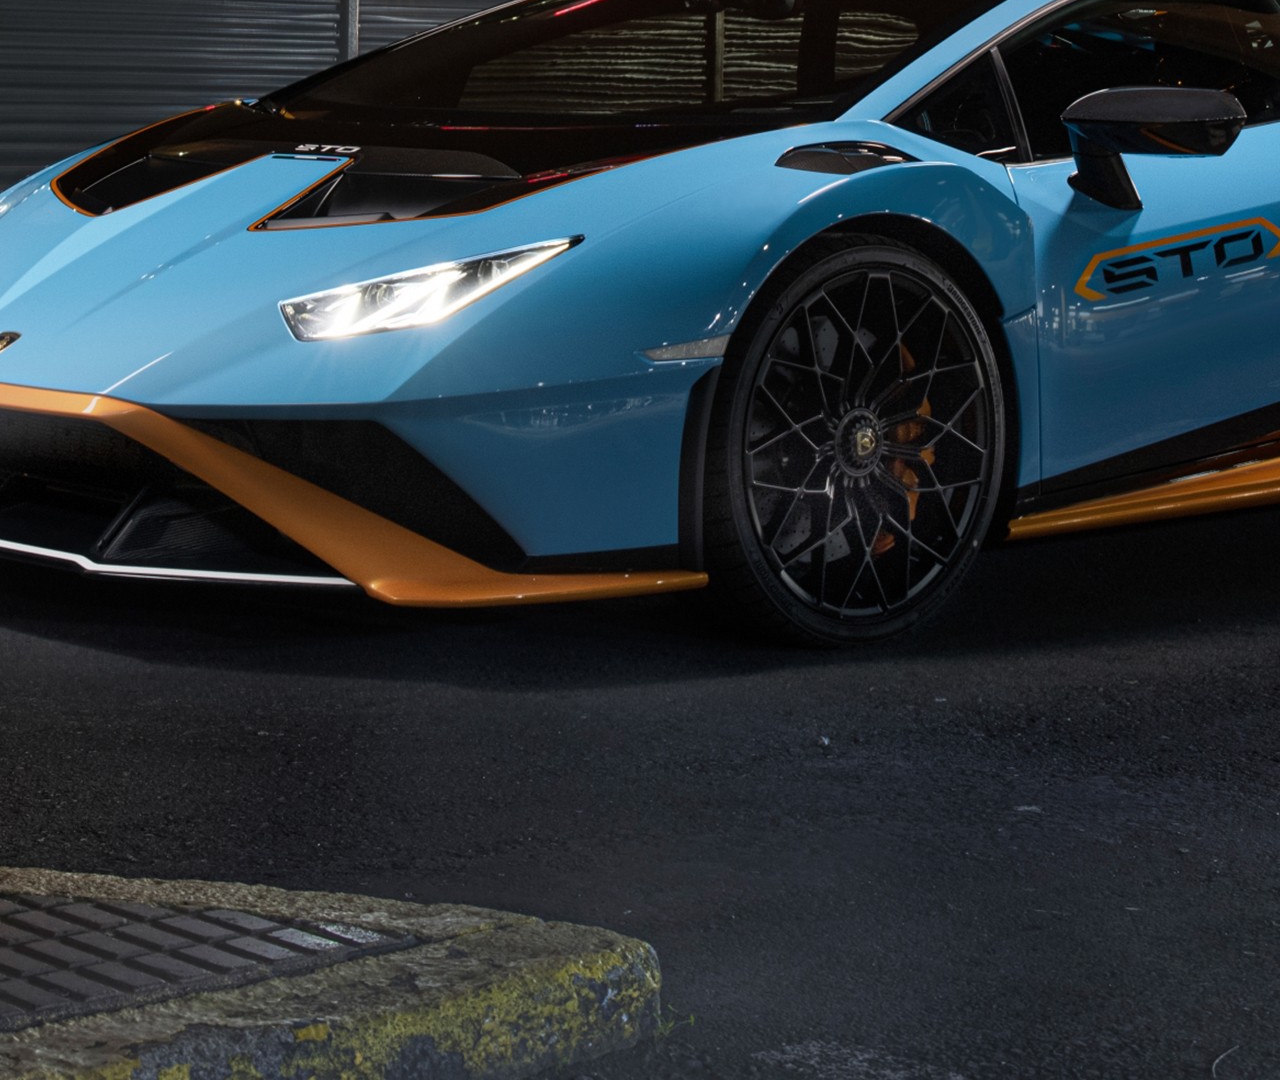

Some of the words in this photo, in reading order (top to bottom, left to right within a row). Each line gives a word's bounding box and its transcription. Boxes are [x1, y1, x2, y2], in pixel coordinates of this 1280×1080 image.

[295, 144, 361, 153] STO
[1102, 230, 1264, 295] STO
[947, 282, 983, 336] BRIDGESTONE
